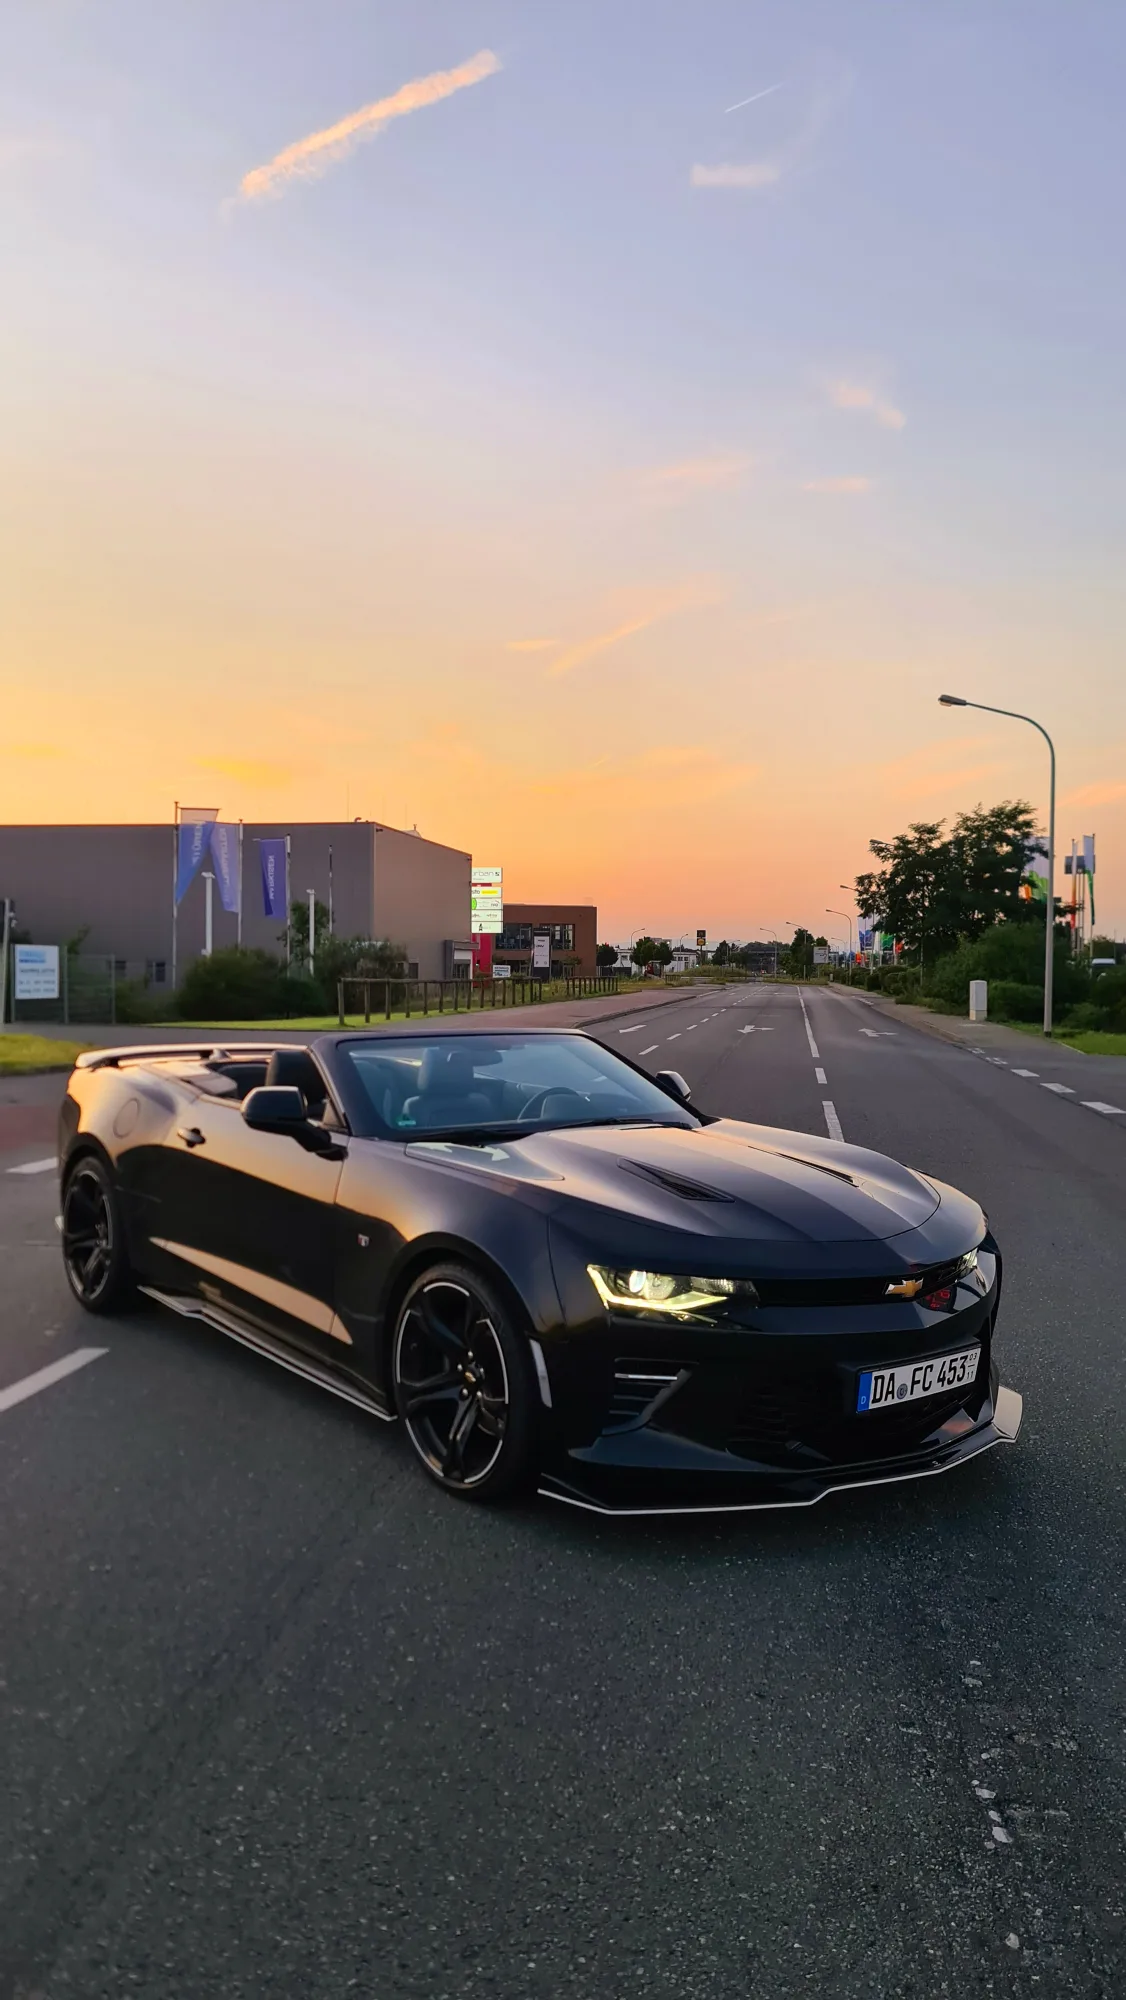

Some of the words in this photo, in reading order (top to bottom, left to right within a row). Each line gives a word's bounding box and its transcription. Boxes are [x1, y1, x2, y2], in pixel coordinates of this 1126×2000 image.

[969, 1352, 978, 1361] 03
[871, 1372, 896, 1404] DA
[909, 1364, 934, 1396] FC
[937, 1355, 969, 1387] 453
[860, 1395, 867, 1405] D
